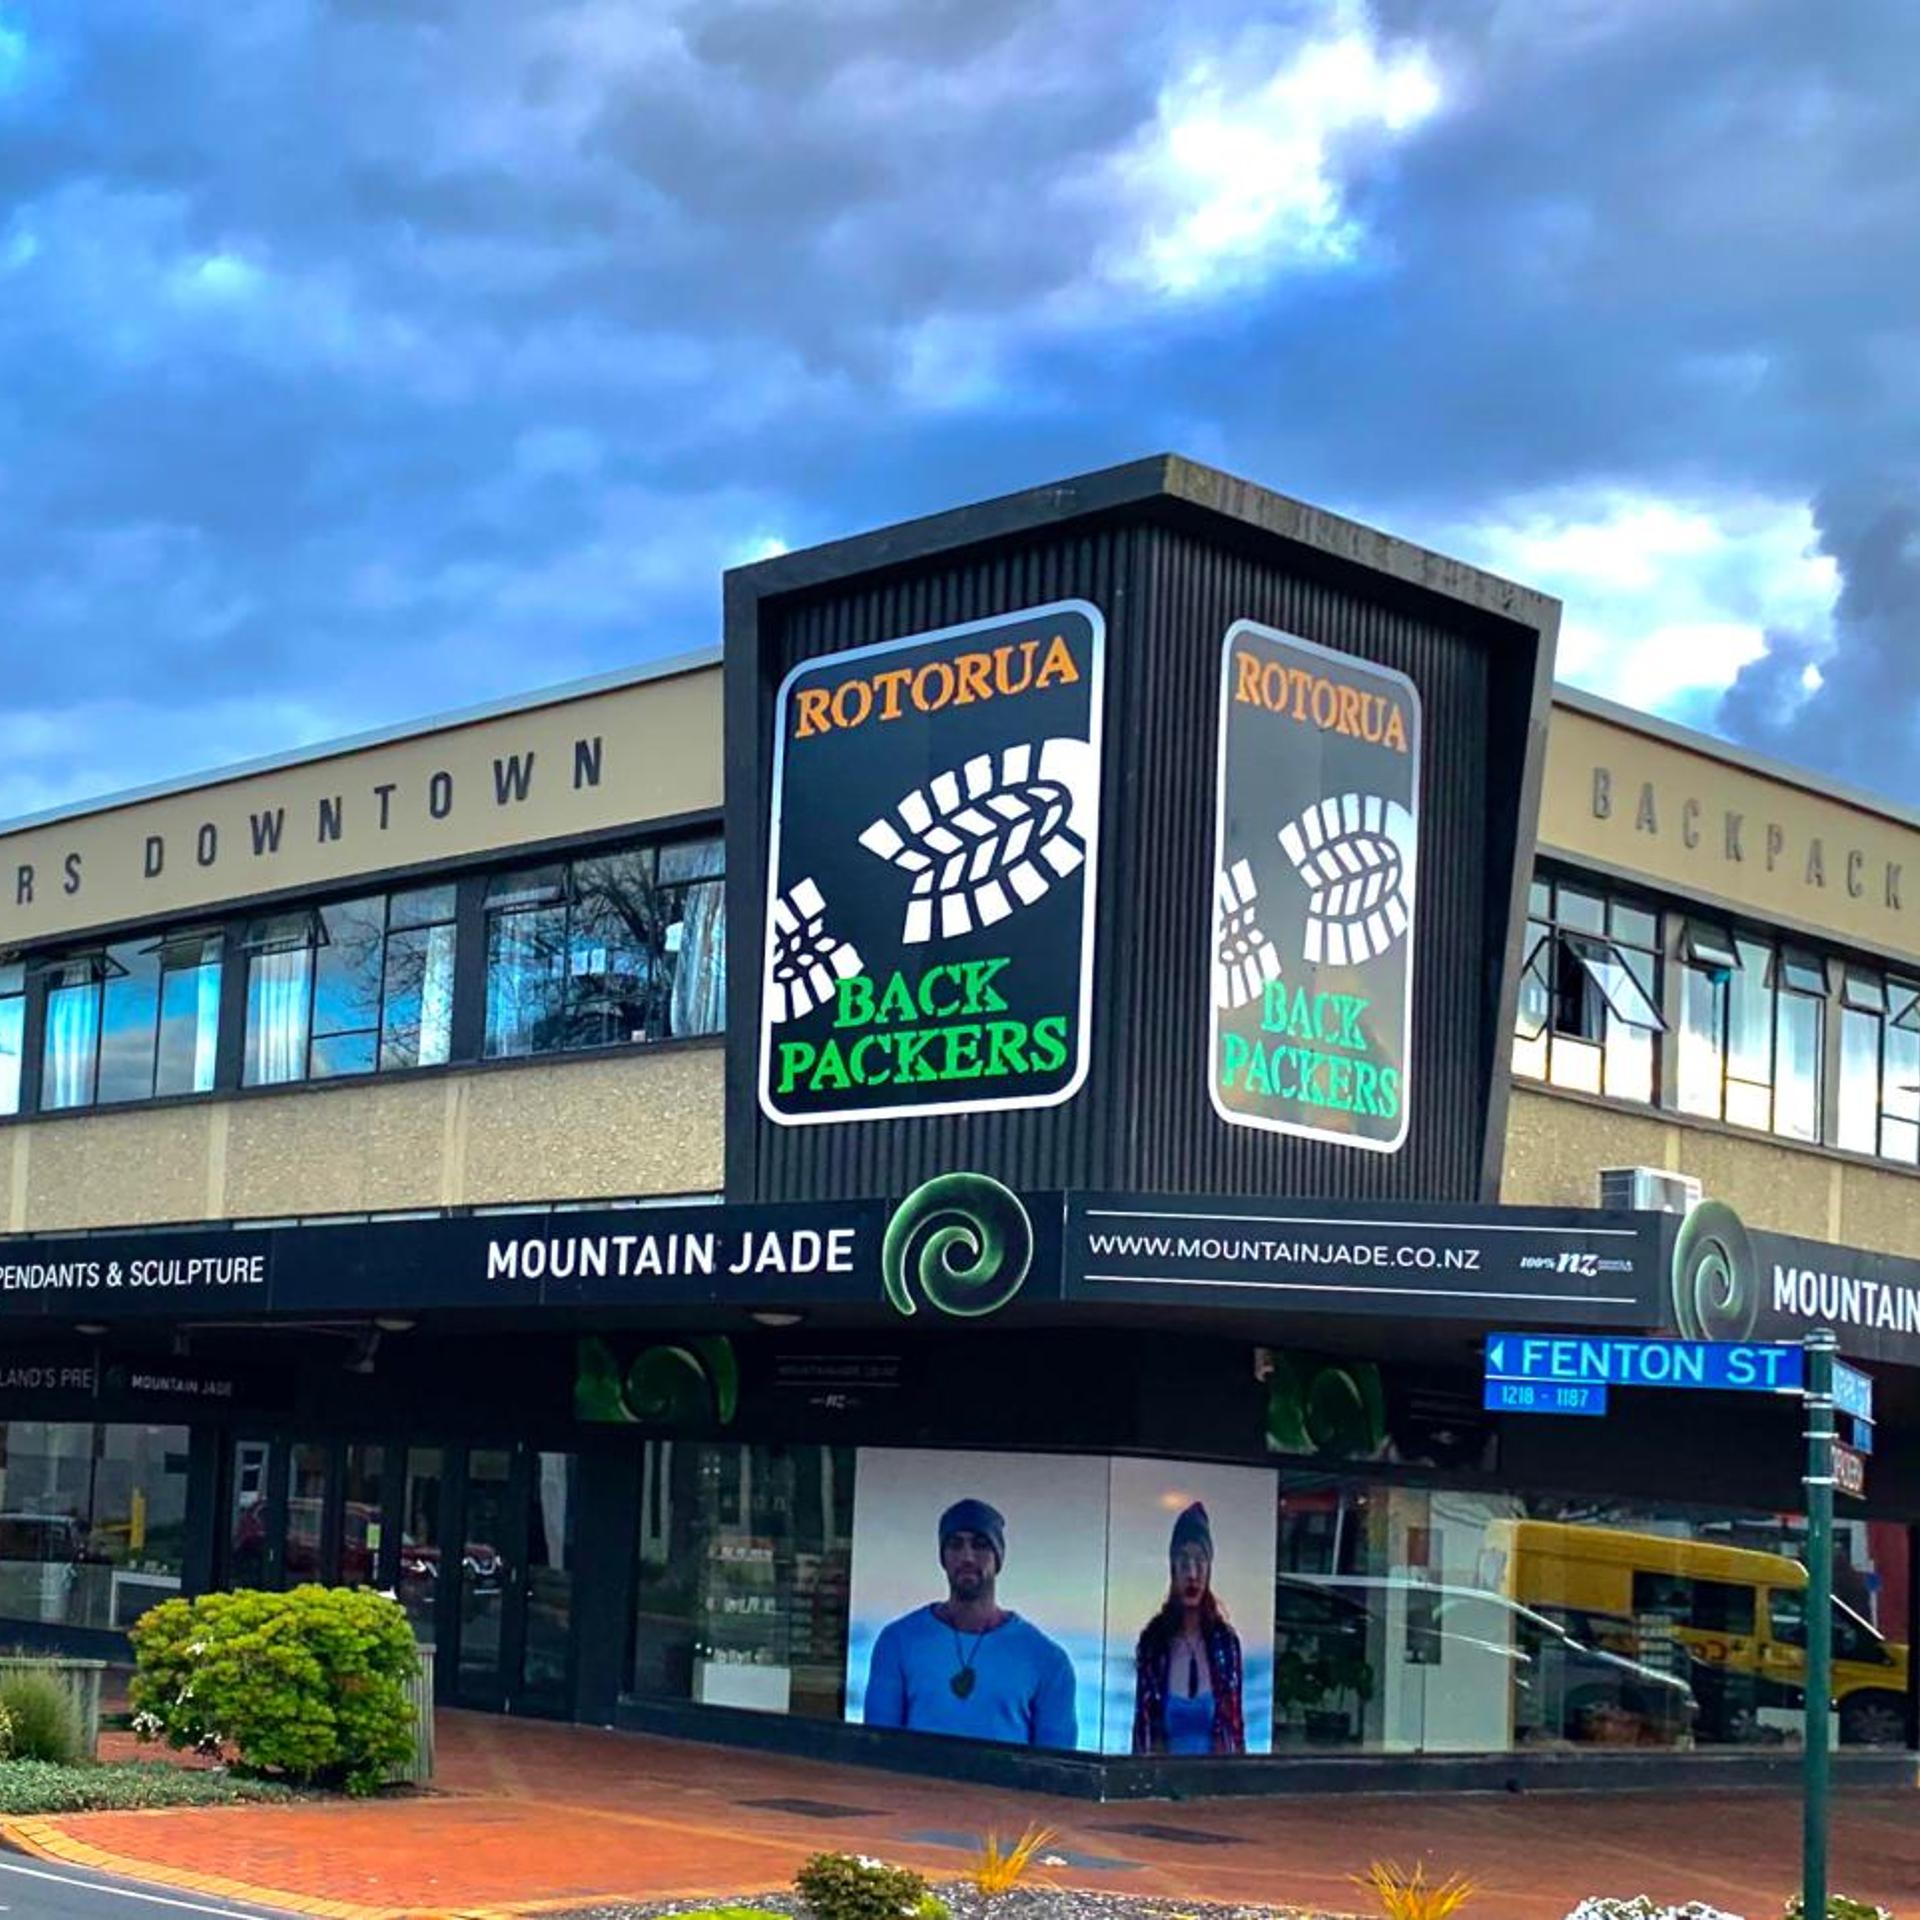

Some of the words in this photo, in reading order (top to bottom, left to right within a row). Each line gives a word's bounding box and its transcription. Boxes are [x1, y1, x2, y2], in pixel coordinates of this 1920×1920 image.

[795, 634, 1079, 738] ROTORUA
[1236, 650, 1407, 752] ROTORUA
[145, 737, 602, 879] DOWNTOWN
[1592, 766, 1903, 910] BACKPACK
[833, 957, 1010, 1028] BACK
[1261, 977, 1370, 1052] BACK
[777, 1016, 1068, 1094] PACKERS
[1221, 1032, 1398, 1119] PACKERS
[106, 1261, 123, 1287] &
[130, 1256, 265, 1287] SCULPTURE
[487, 1233, 715, 1279] MOUNTAIN
[729, 1228, 856, 1274] JADE
[1089, 1234, 1481, 1270] WWW.MOUNTAINJADE.CO.NZ
[1774, 1264, 1920, 1334] MOUNTAIN
[1502, 1384, 1534, 1406] 1218
[1556, 1387, 1588, 1408] 1187
[1522, 1339, 1704, 1382] FENTON
[1727, 1348, 1787, 1385] ST
